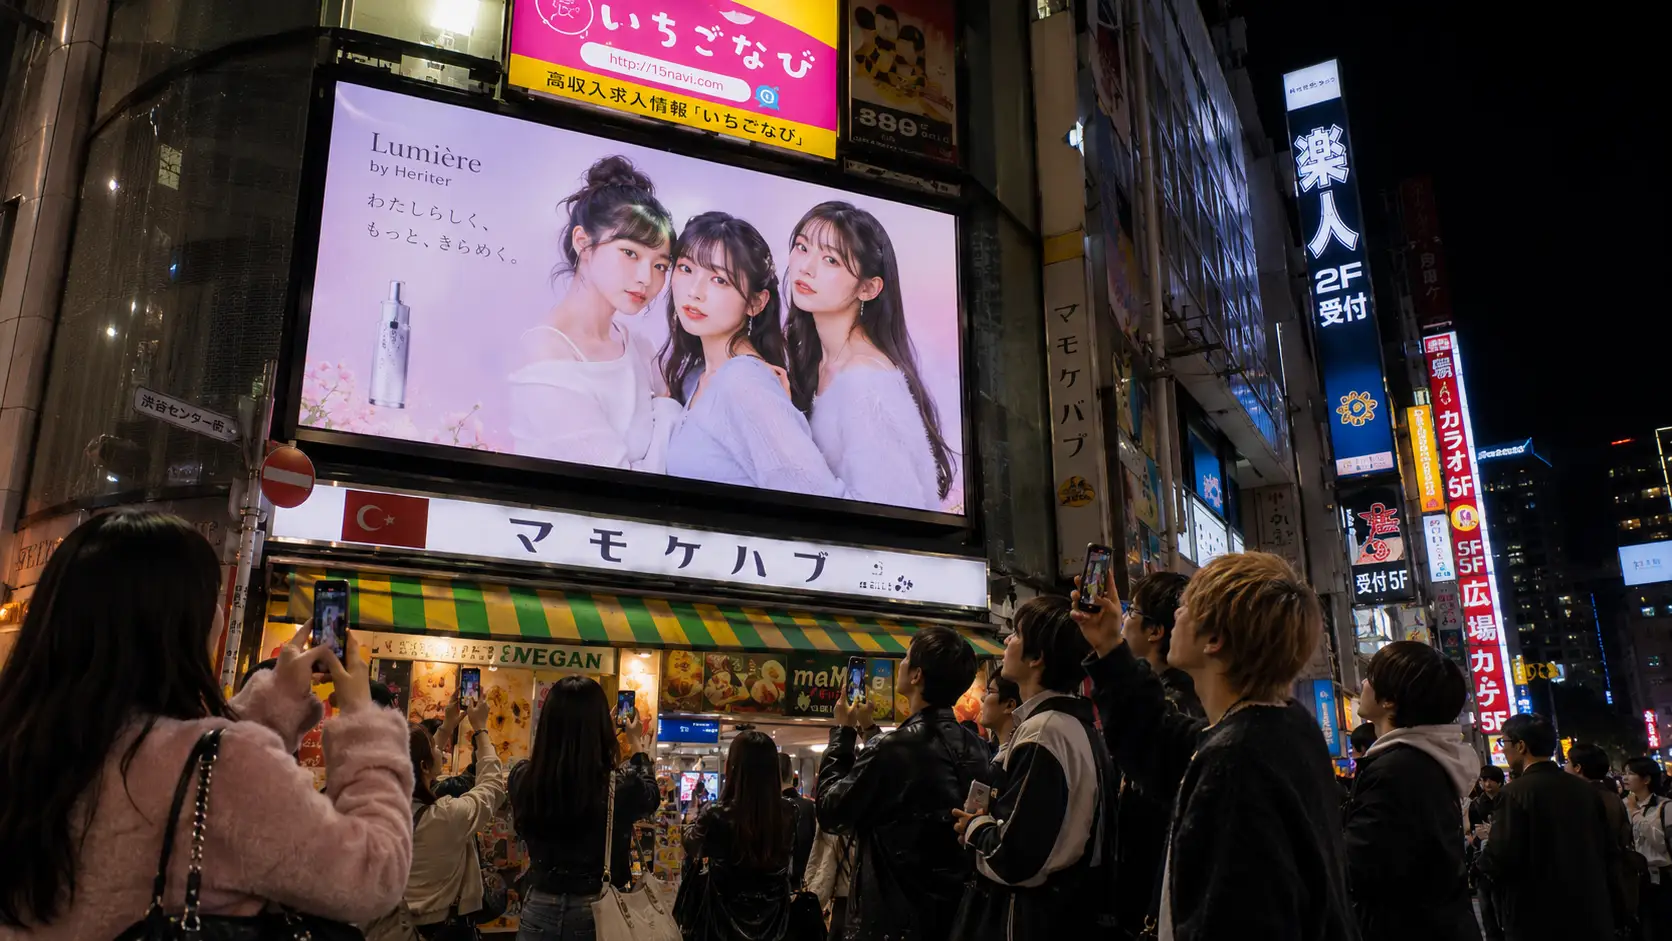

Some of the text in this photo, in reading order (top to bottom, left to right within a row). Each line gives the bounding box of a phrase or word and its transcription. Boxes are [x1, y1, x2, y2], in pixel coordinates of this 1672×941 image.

[600, 3, 816, 79] いちごなび
[609, 52, 724, 92] http://15navi.com
[370, 131, 482, 174] Lumière
[370, 160, 452, 187] by Heriter
[1294, 123, 1360, 259] 楽人
[367, 193, 489, 232] わたしらしく、
[367, 221, 518, 265] もっと、きらめく。
[1315, 261, 1363, 294] 2F
[1319, 292, 1367, 327] 受付
[1054, 303, 1088, 458] マモケバブ
[1449, 475, 1473, 498] 5F
